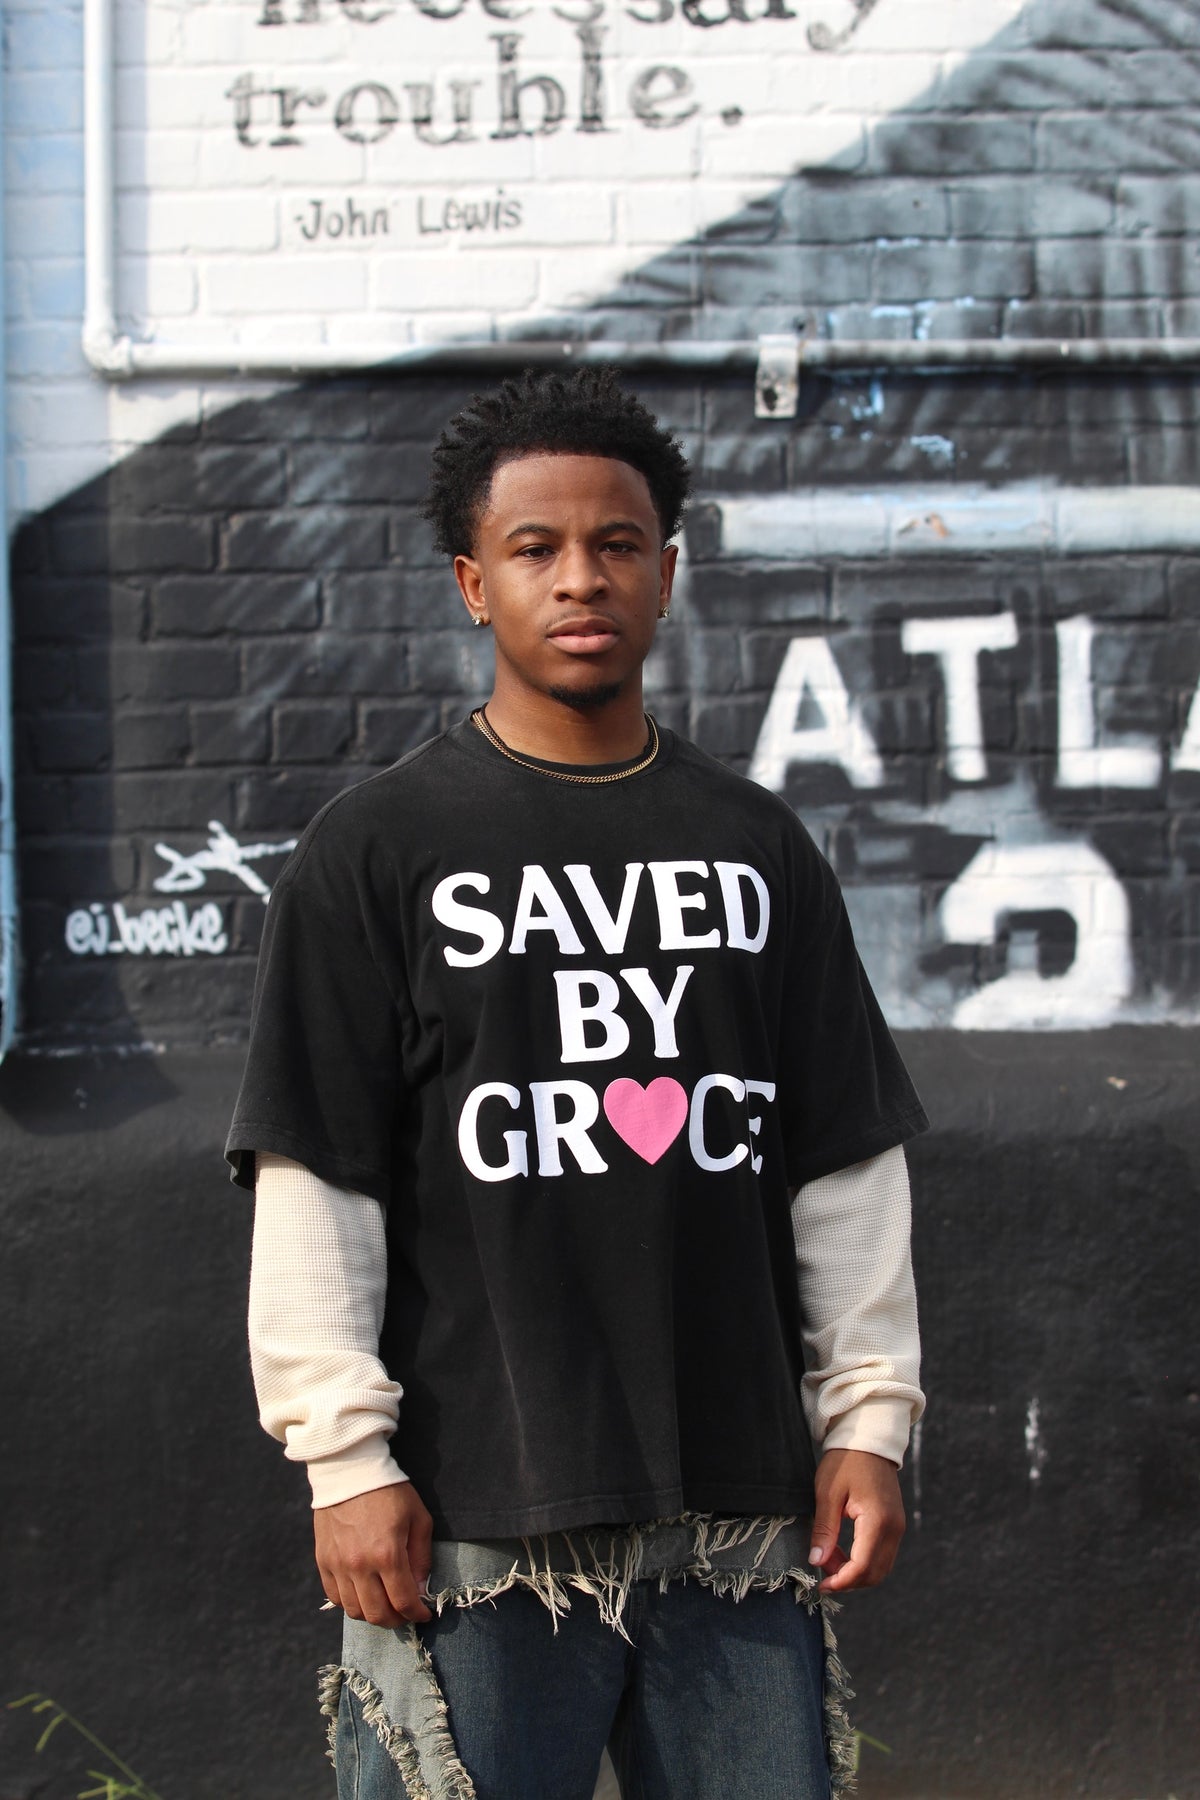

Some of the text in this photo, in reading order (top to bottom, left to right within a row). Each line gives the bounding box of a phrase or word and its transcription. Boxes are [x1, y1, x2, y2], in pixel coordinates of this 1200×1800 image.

[226, 24, 746, 147] trouble.
[417, 189, 523, 235] Lewis
[431, 860, 771, 968] SAVED
[552, 965, 695, 1064] BY
